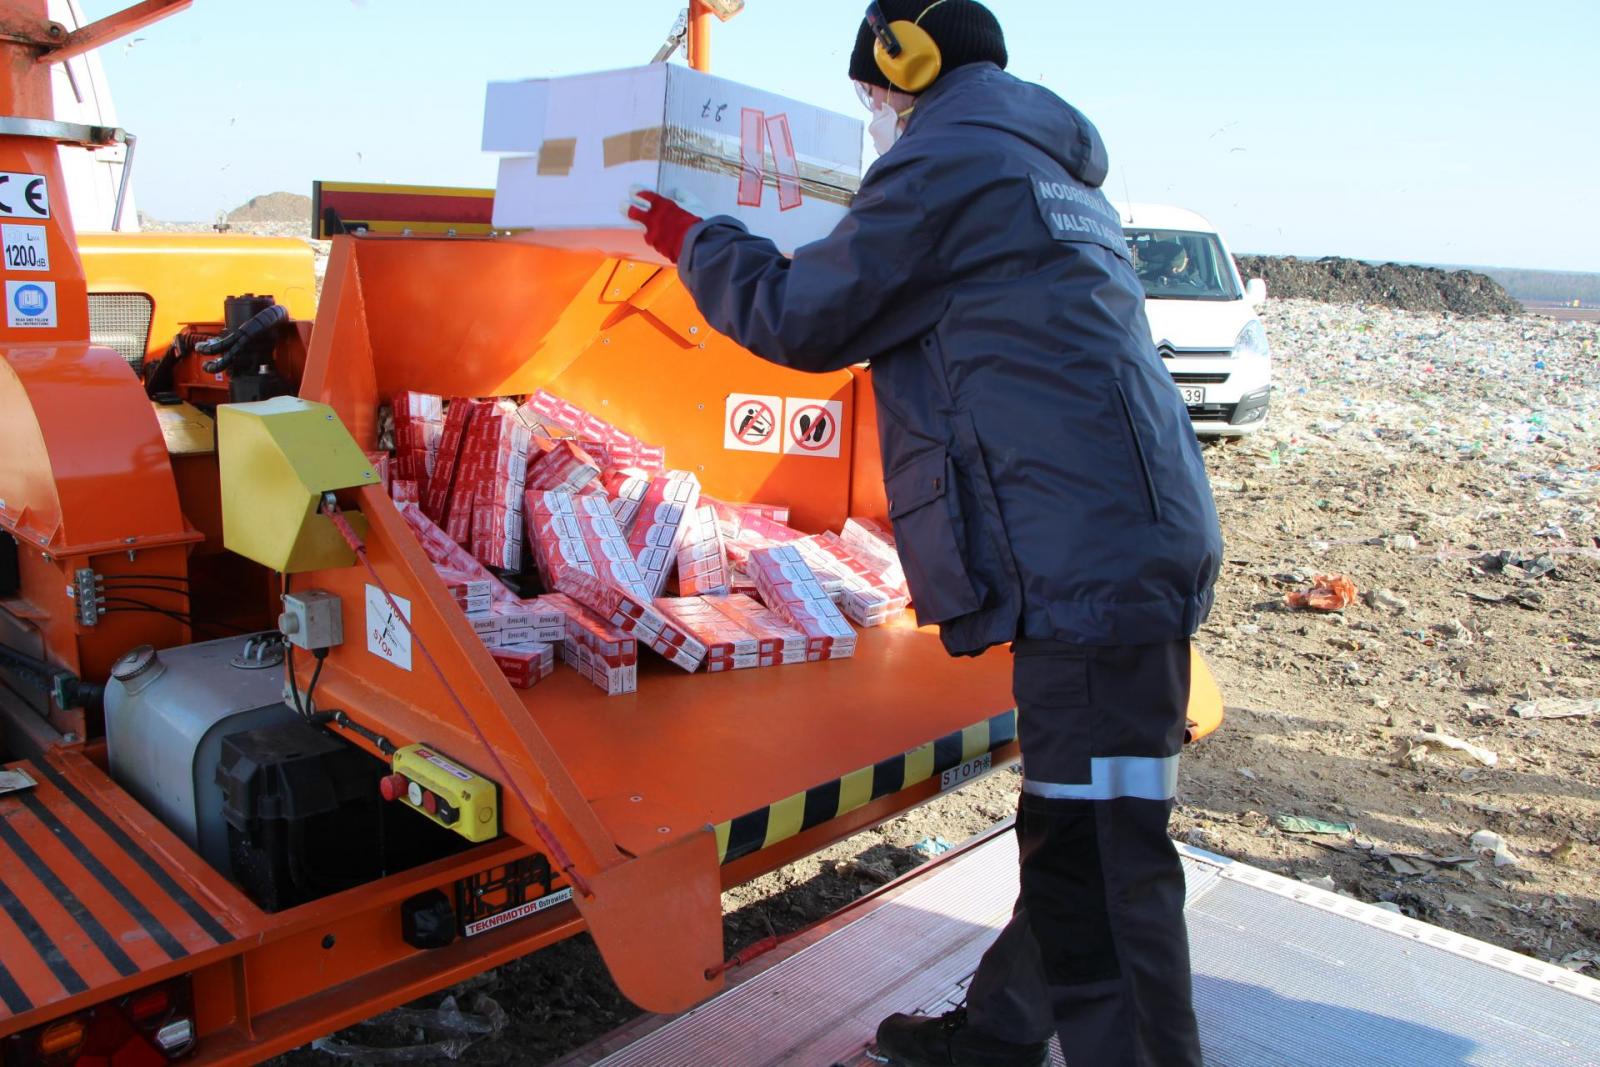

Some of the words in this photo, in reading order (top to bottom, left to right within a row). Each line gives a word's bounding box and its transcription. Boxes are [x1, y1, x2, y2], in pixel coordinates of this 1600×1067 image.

[373, 629, 393, 657] STOP
[943, 760, 979, 785] STOP
[468, 903, 537, 934] TEKNAMOTOR
